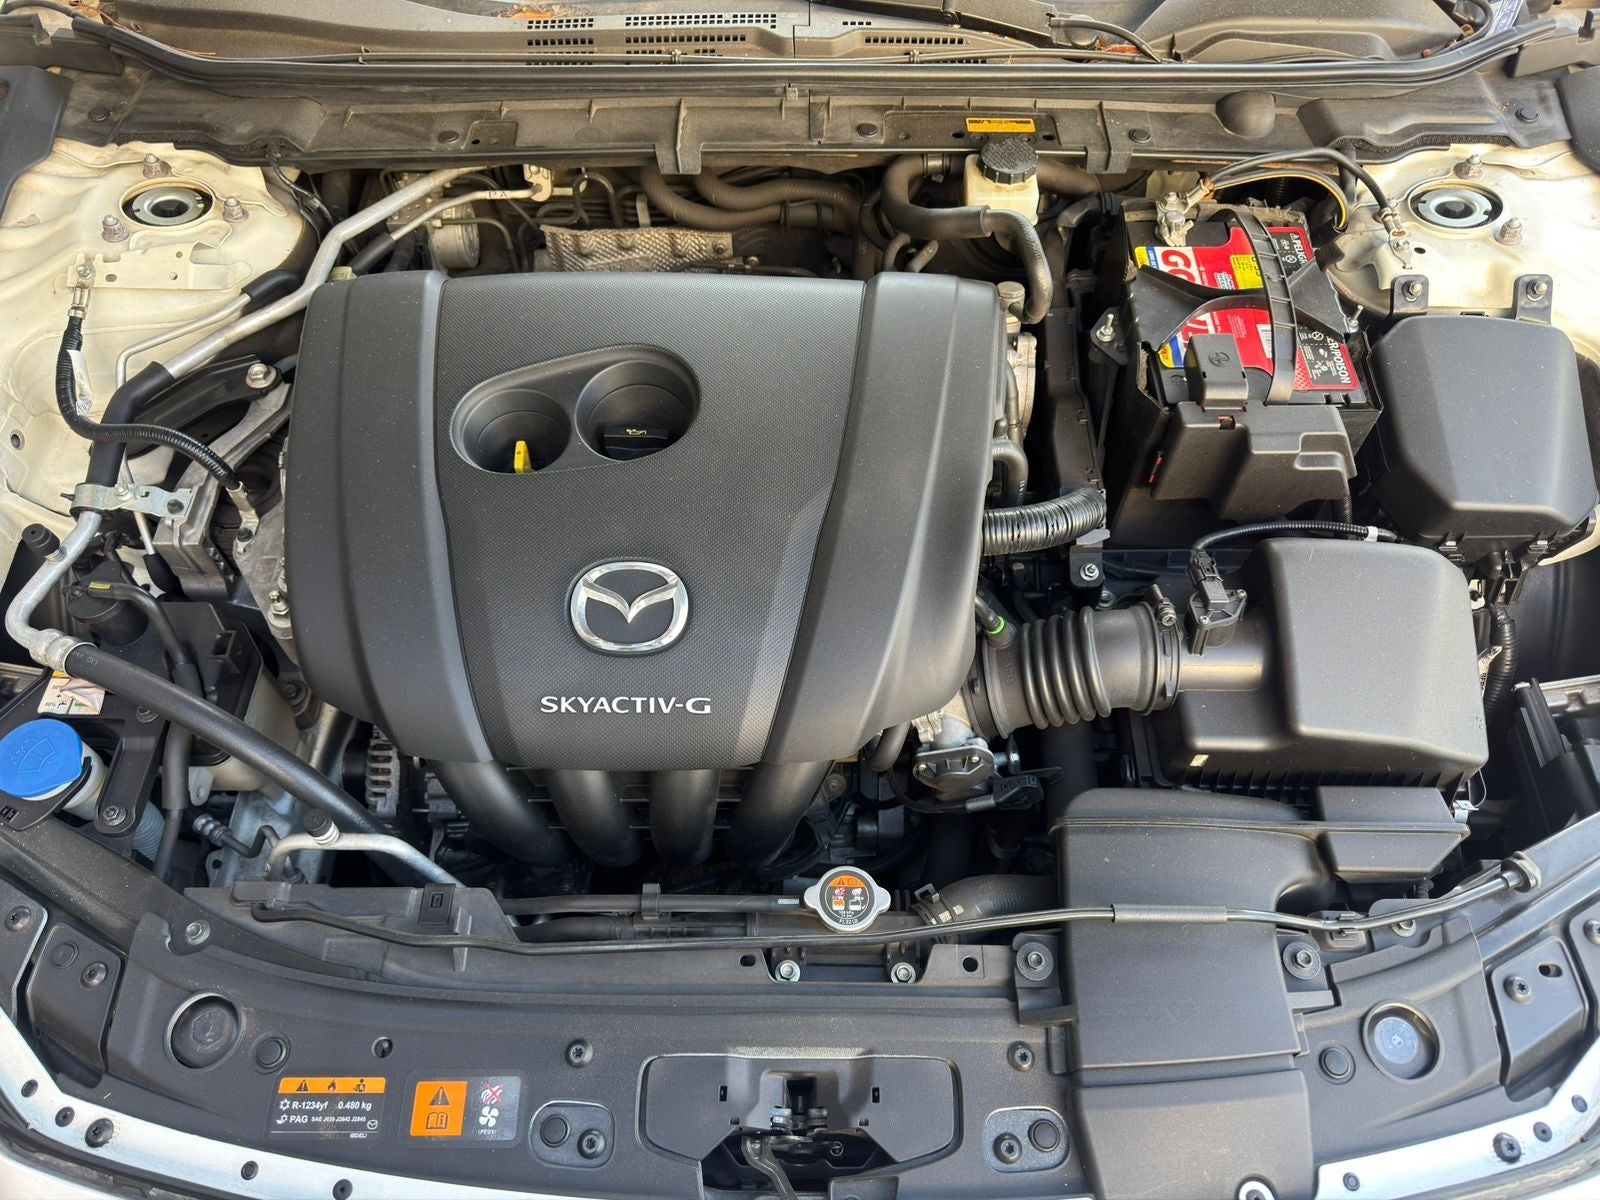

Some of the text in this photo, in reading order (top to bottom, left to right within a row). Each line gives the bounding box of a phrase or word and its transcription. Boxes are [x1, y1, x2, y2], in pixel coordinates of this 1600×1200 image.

[1293, 239, 1307, 267] PELIGR
[540, 696, 712, 714] SKYACTIV-G
[291, 1101, 372, 1111] R-1234yf 0.480 kg
[289, 1115, 308, 1123] PAG
